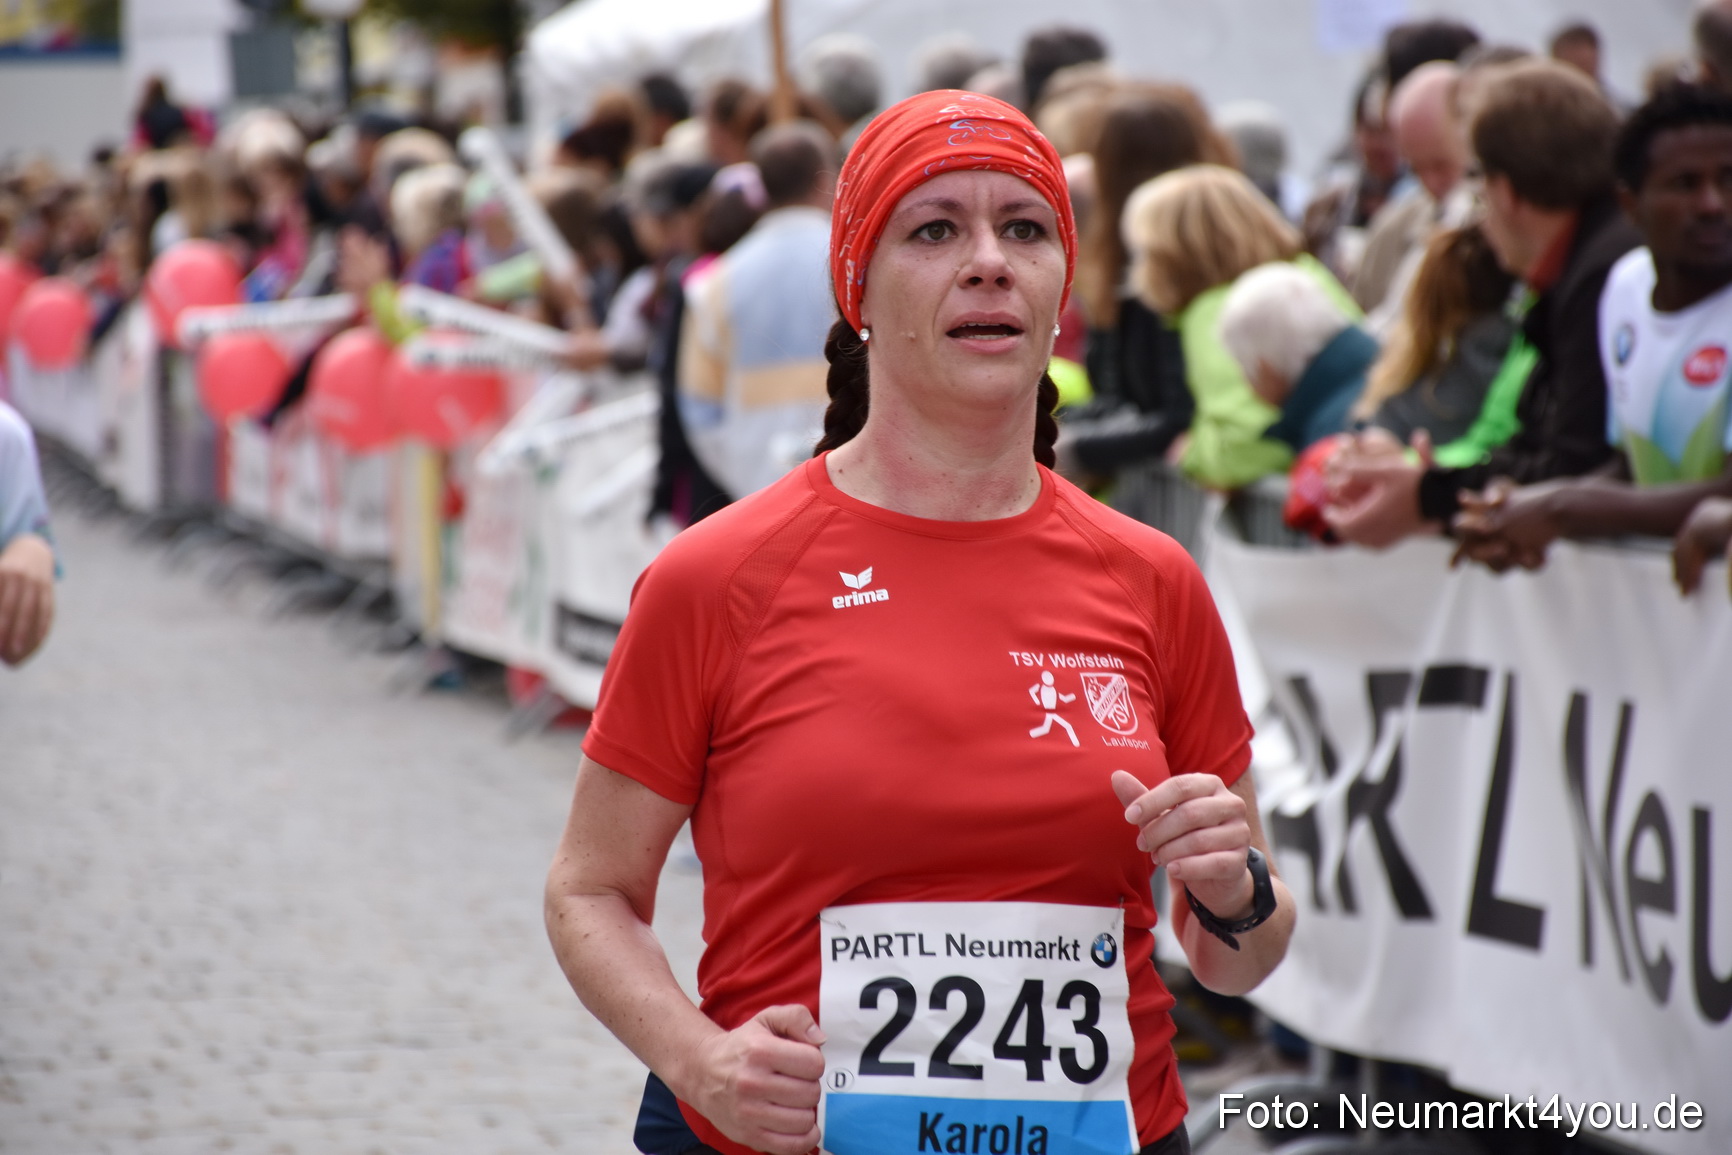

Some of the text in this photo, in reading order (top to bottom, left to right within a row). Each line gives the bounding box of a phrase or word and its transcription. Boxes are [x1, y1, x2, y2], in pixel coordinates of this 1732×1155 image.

[832, 588, 890, 609] erima
[1009, 651, 1125, 670] TSV Wolfstein
[1101, 735, 1151, 751] Laufsport
[1262, 664, 1732, 1025] ARTL Neu
[831, 933, 1081, 962] PARTL Neumarkt
[858, 975, 1109, 1085] 2243
[834, 1071, 847, 1089] D
[918, 1111, 1048, 1155] Karola
